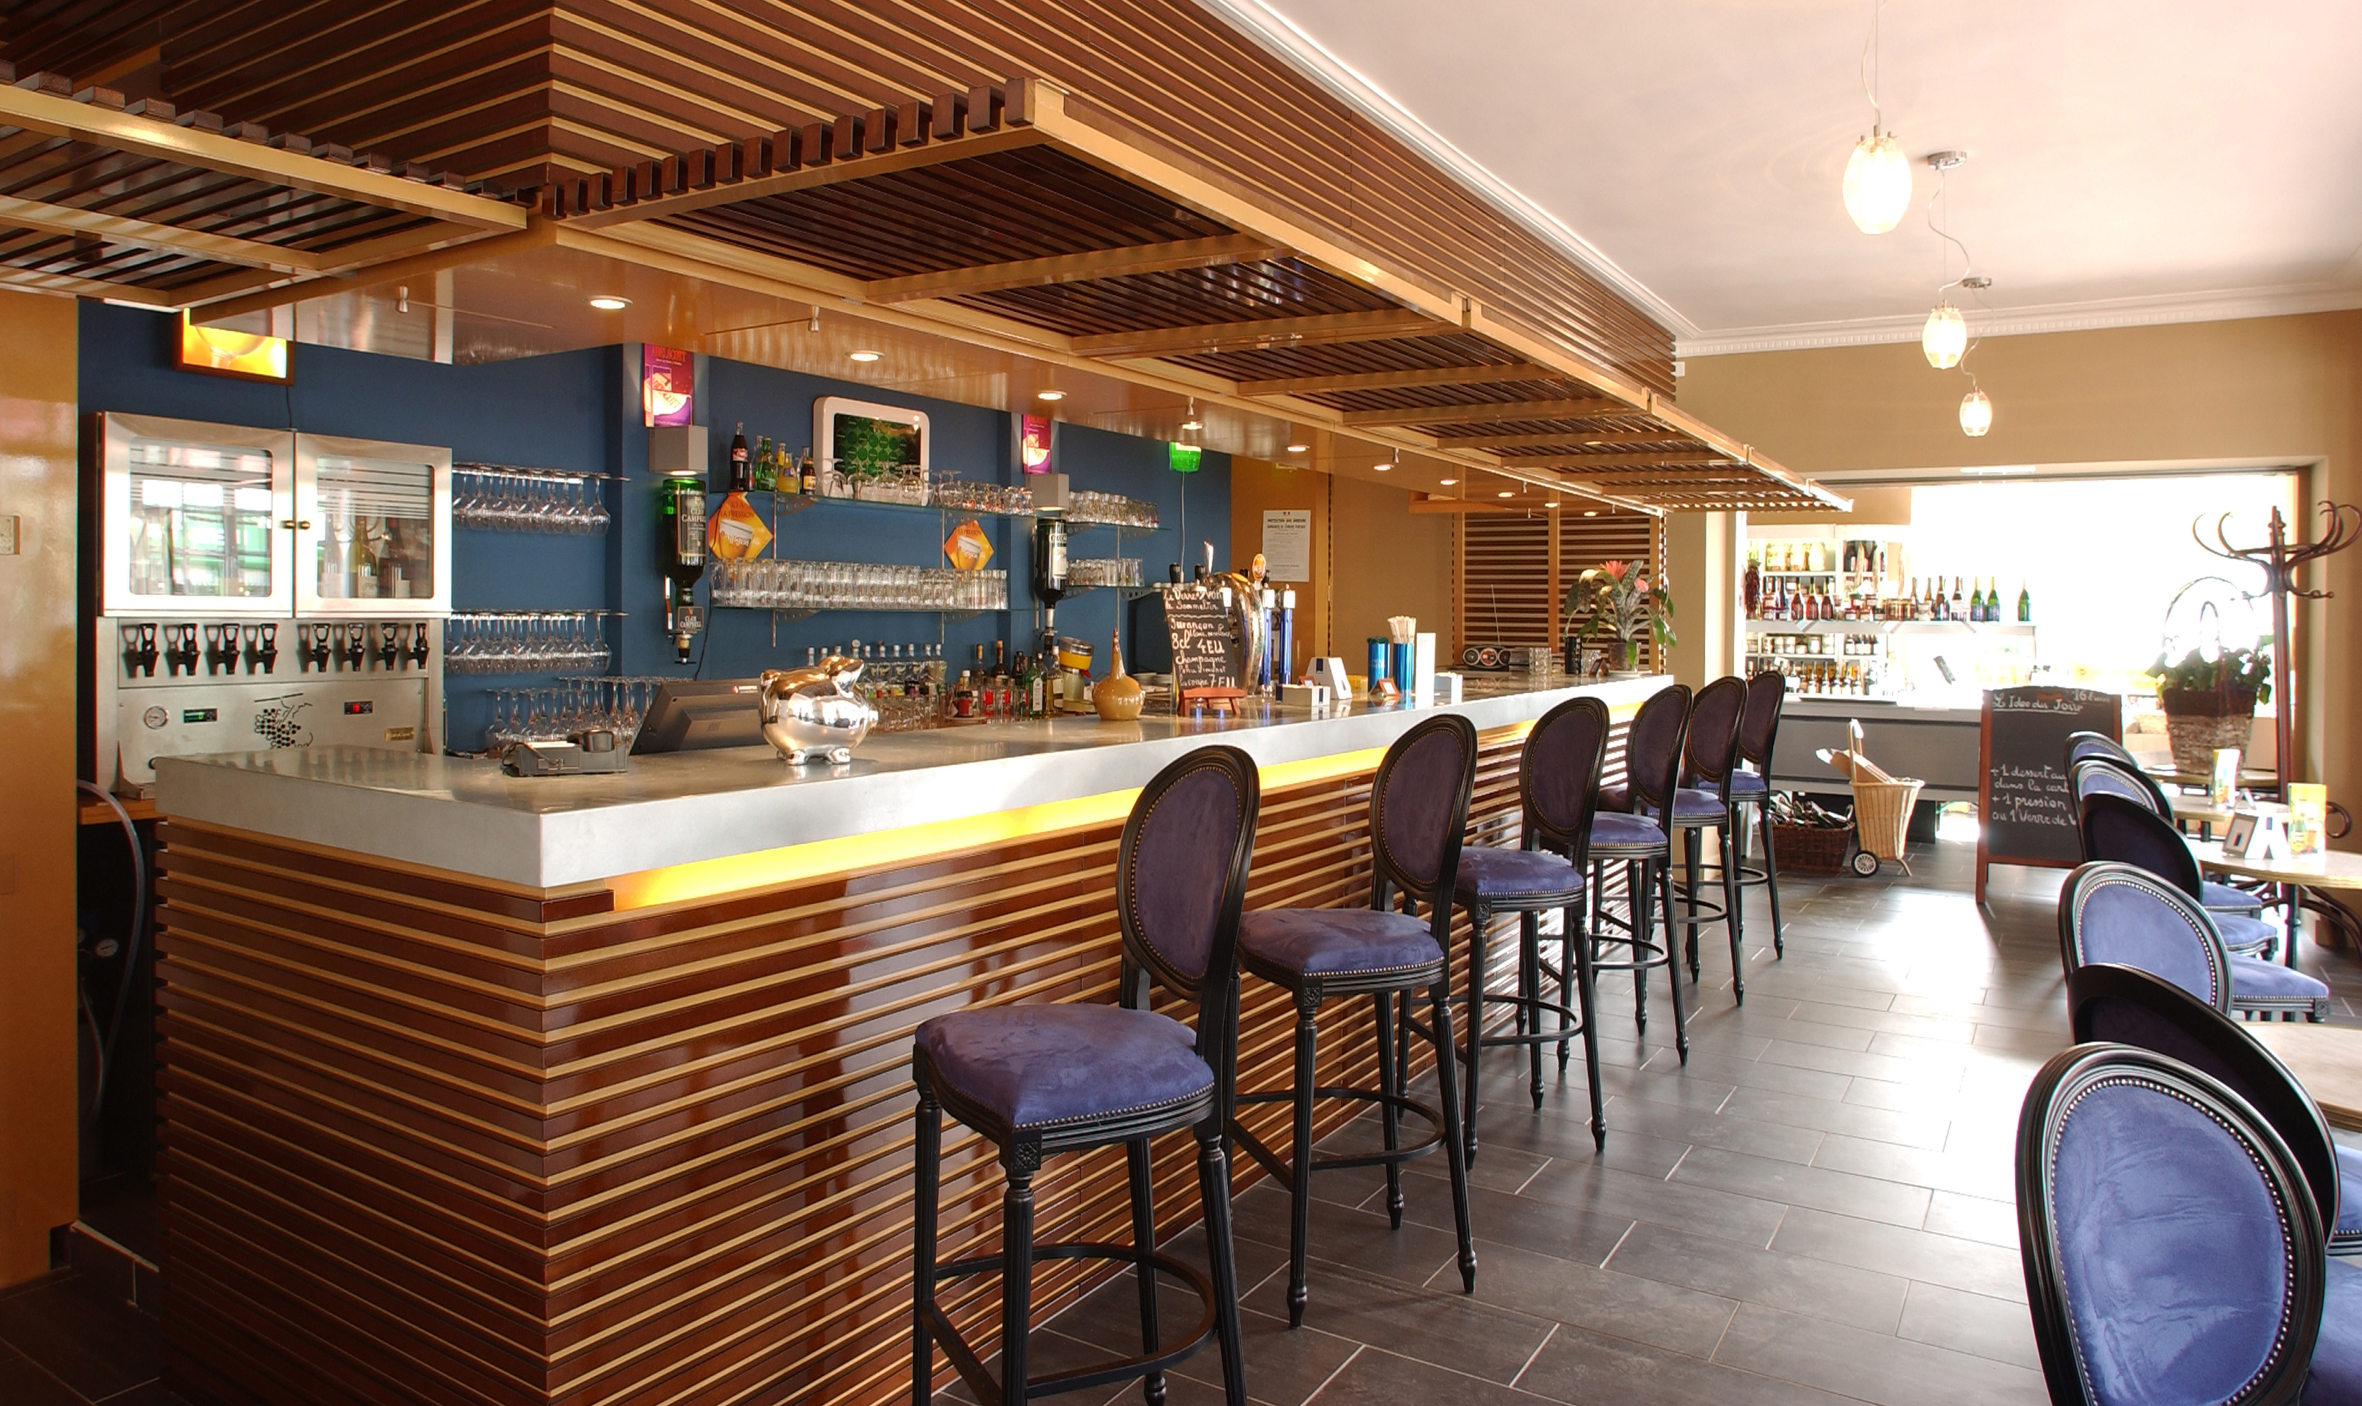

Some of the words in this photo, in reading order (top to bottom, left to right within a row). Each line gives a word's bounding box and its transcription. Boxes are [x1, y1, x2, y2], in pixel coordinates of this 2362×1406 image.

[1175, 649, 1226, 669] Champagne
[2011, 765, 2051, 779] dessert
[1995, 778, 2023, 789] dans
[2028, 779, 2041, 791] la
[2046, 781, 2070, 793] cart
[2015, 796, 2067, 811] pression
